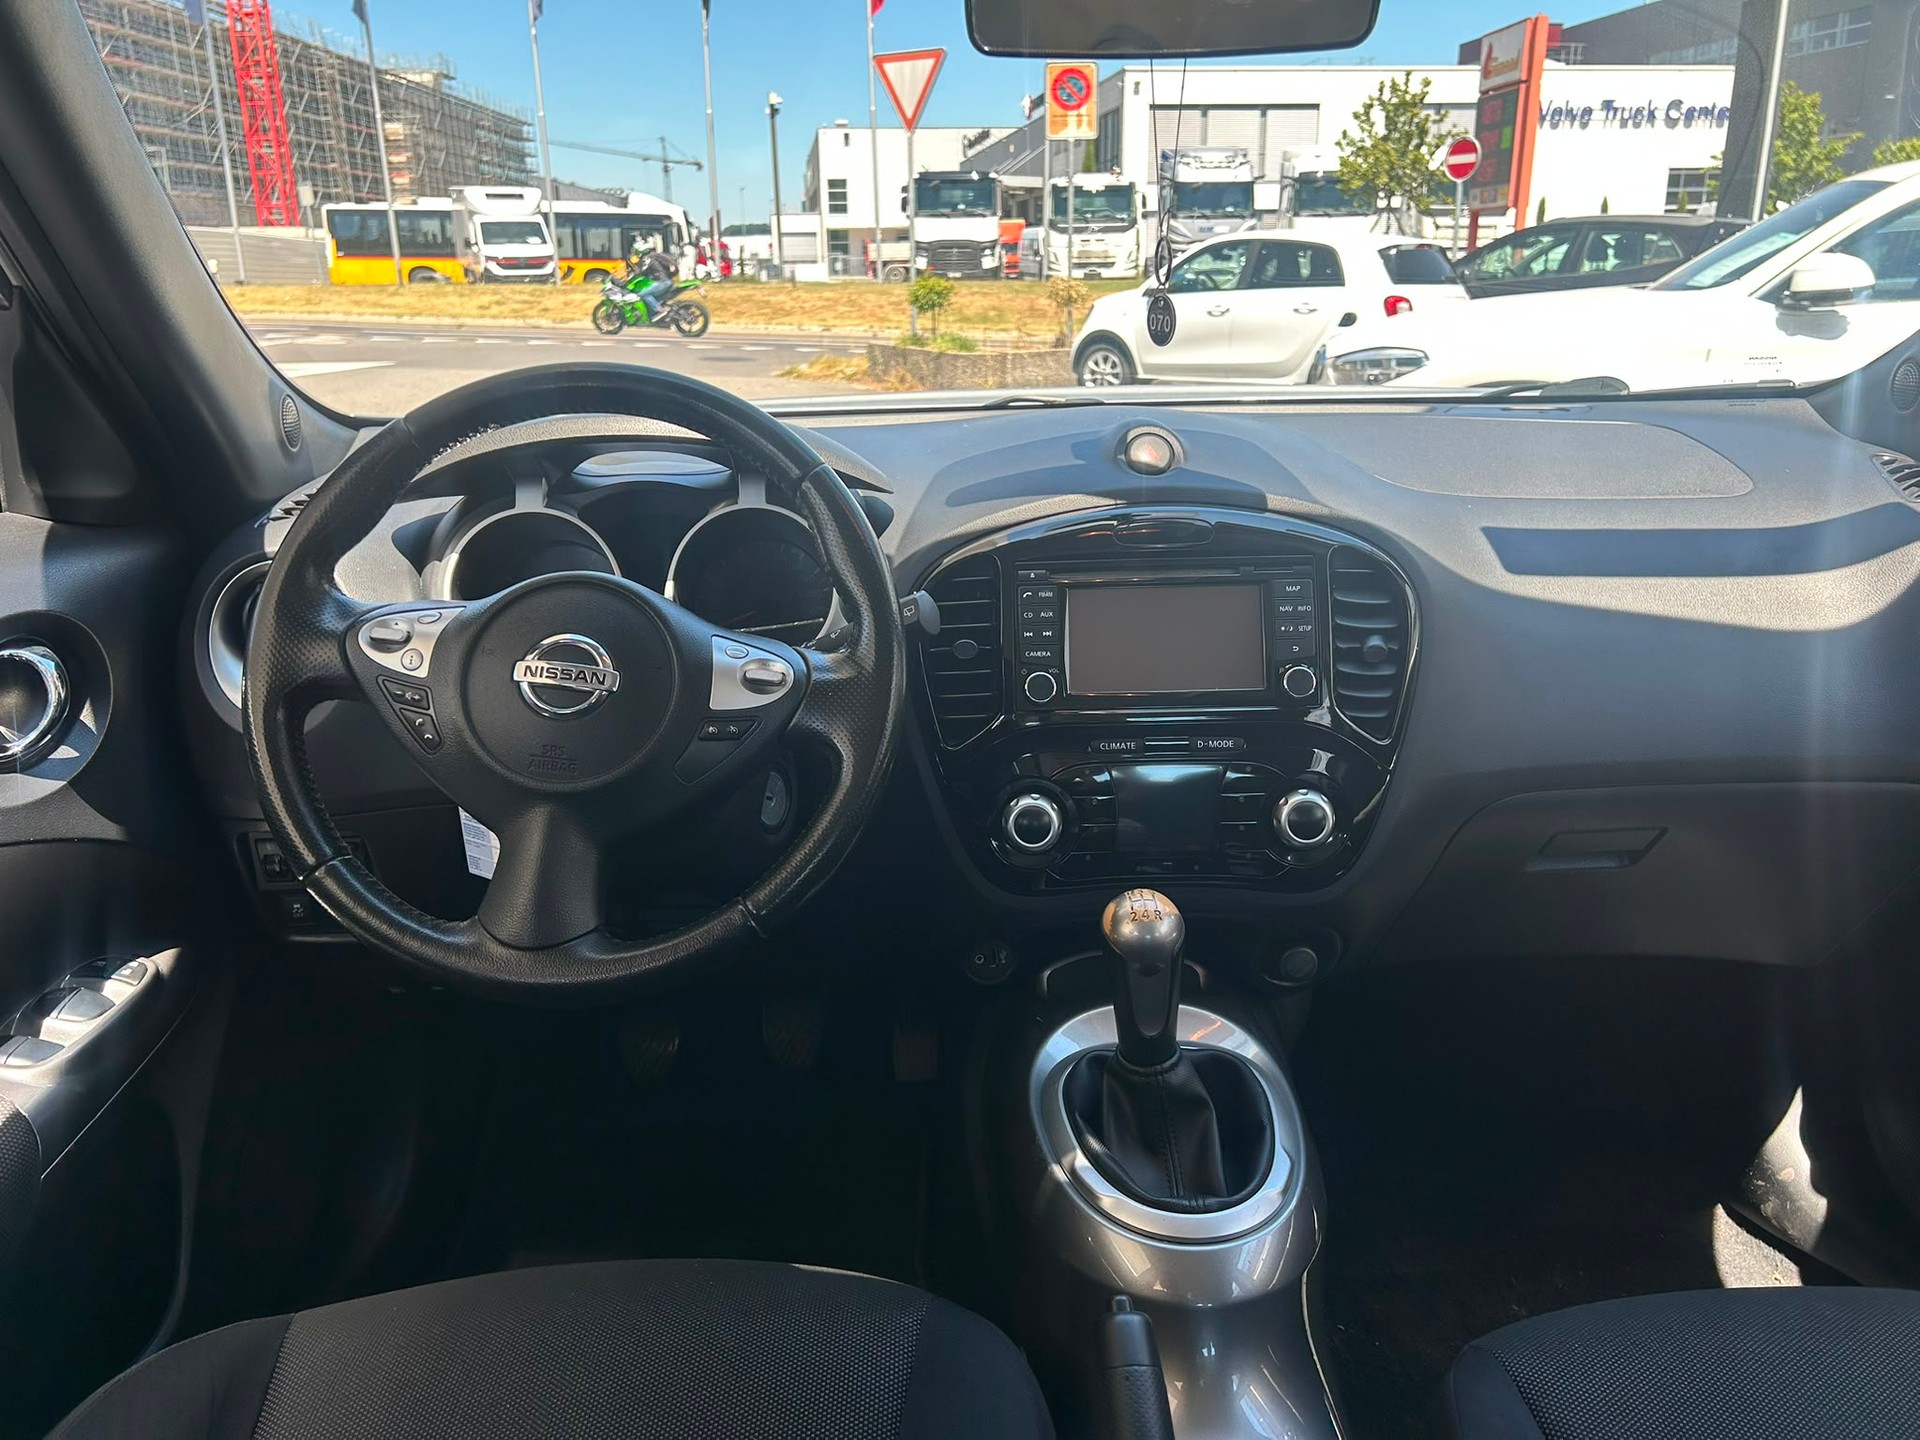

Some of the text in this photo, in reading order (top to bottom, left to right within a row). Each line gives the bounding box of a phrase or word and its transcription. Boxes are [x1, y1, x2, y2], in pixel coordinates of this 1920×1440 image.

[1601, 99, 1658, 123] Truck
[1664, 99, 1730, 123] Cente
[1149, 313, 1171, 333] 070
[523, 664, 607, 686] NISSAN
[1099, 740, 1235, 750] CLIMATE D-MODE
